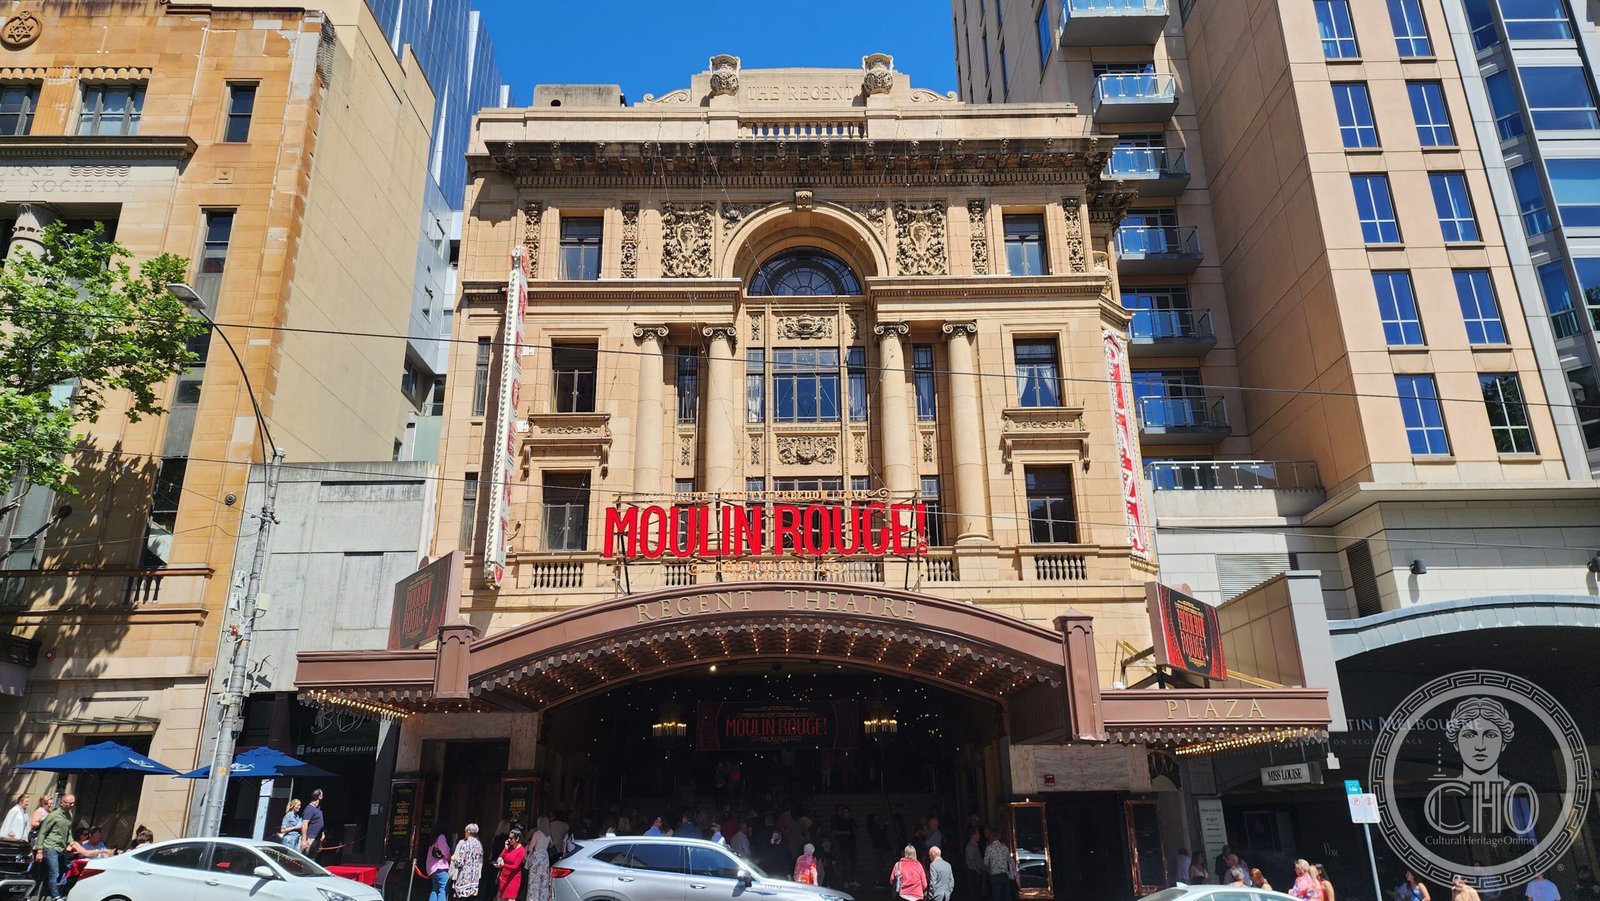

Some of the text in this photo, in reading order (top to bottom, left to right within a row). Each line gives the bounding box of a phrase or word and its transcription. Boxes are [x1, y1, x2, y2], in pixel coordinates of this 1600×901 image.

[747, 86, 854, 100] THE REGENT
[30, 179, 129, 193] SOCIETY
[603, 502, 928, 559] MOULIN ROUGE!
[635, 589, 917, 623] REGENT THEATRE
[1165, 698, 1266, 720] PLAZA
[725, 717, 828, 737] MOULIN ROUGE!
[1268, 767, 1303, 781] MISS LOUISE
